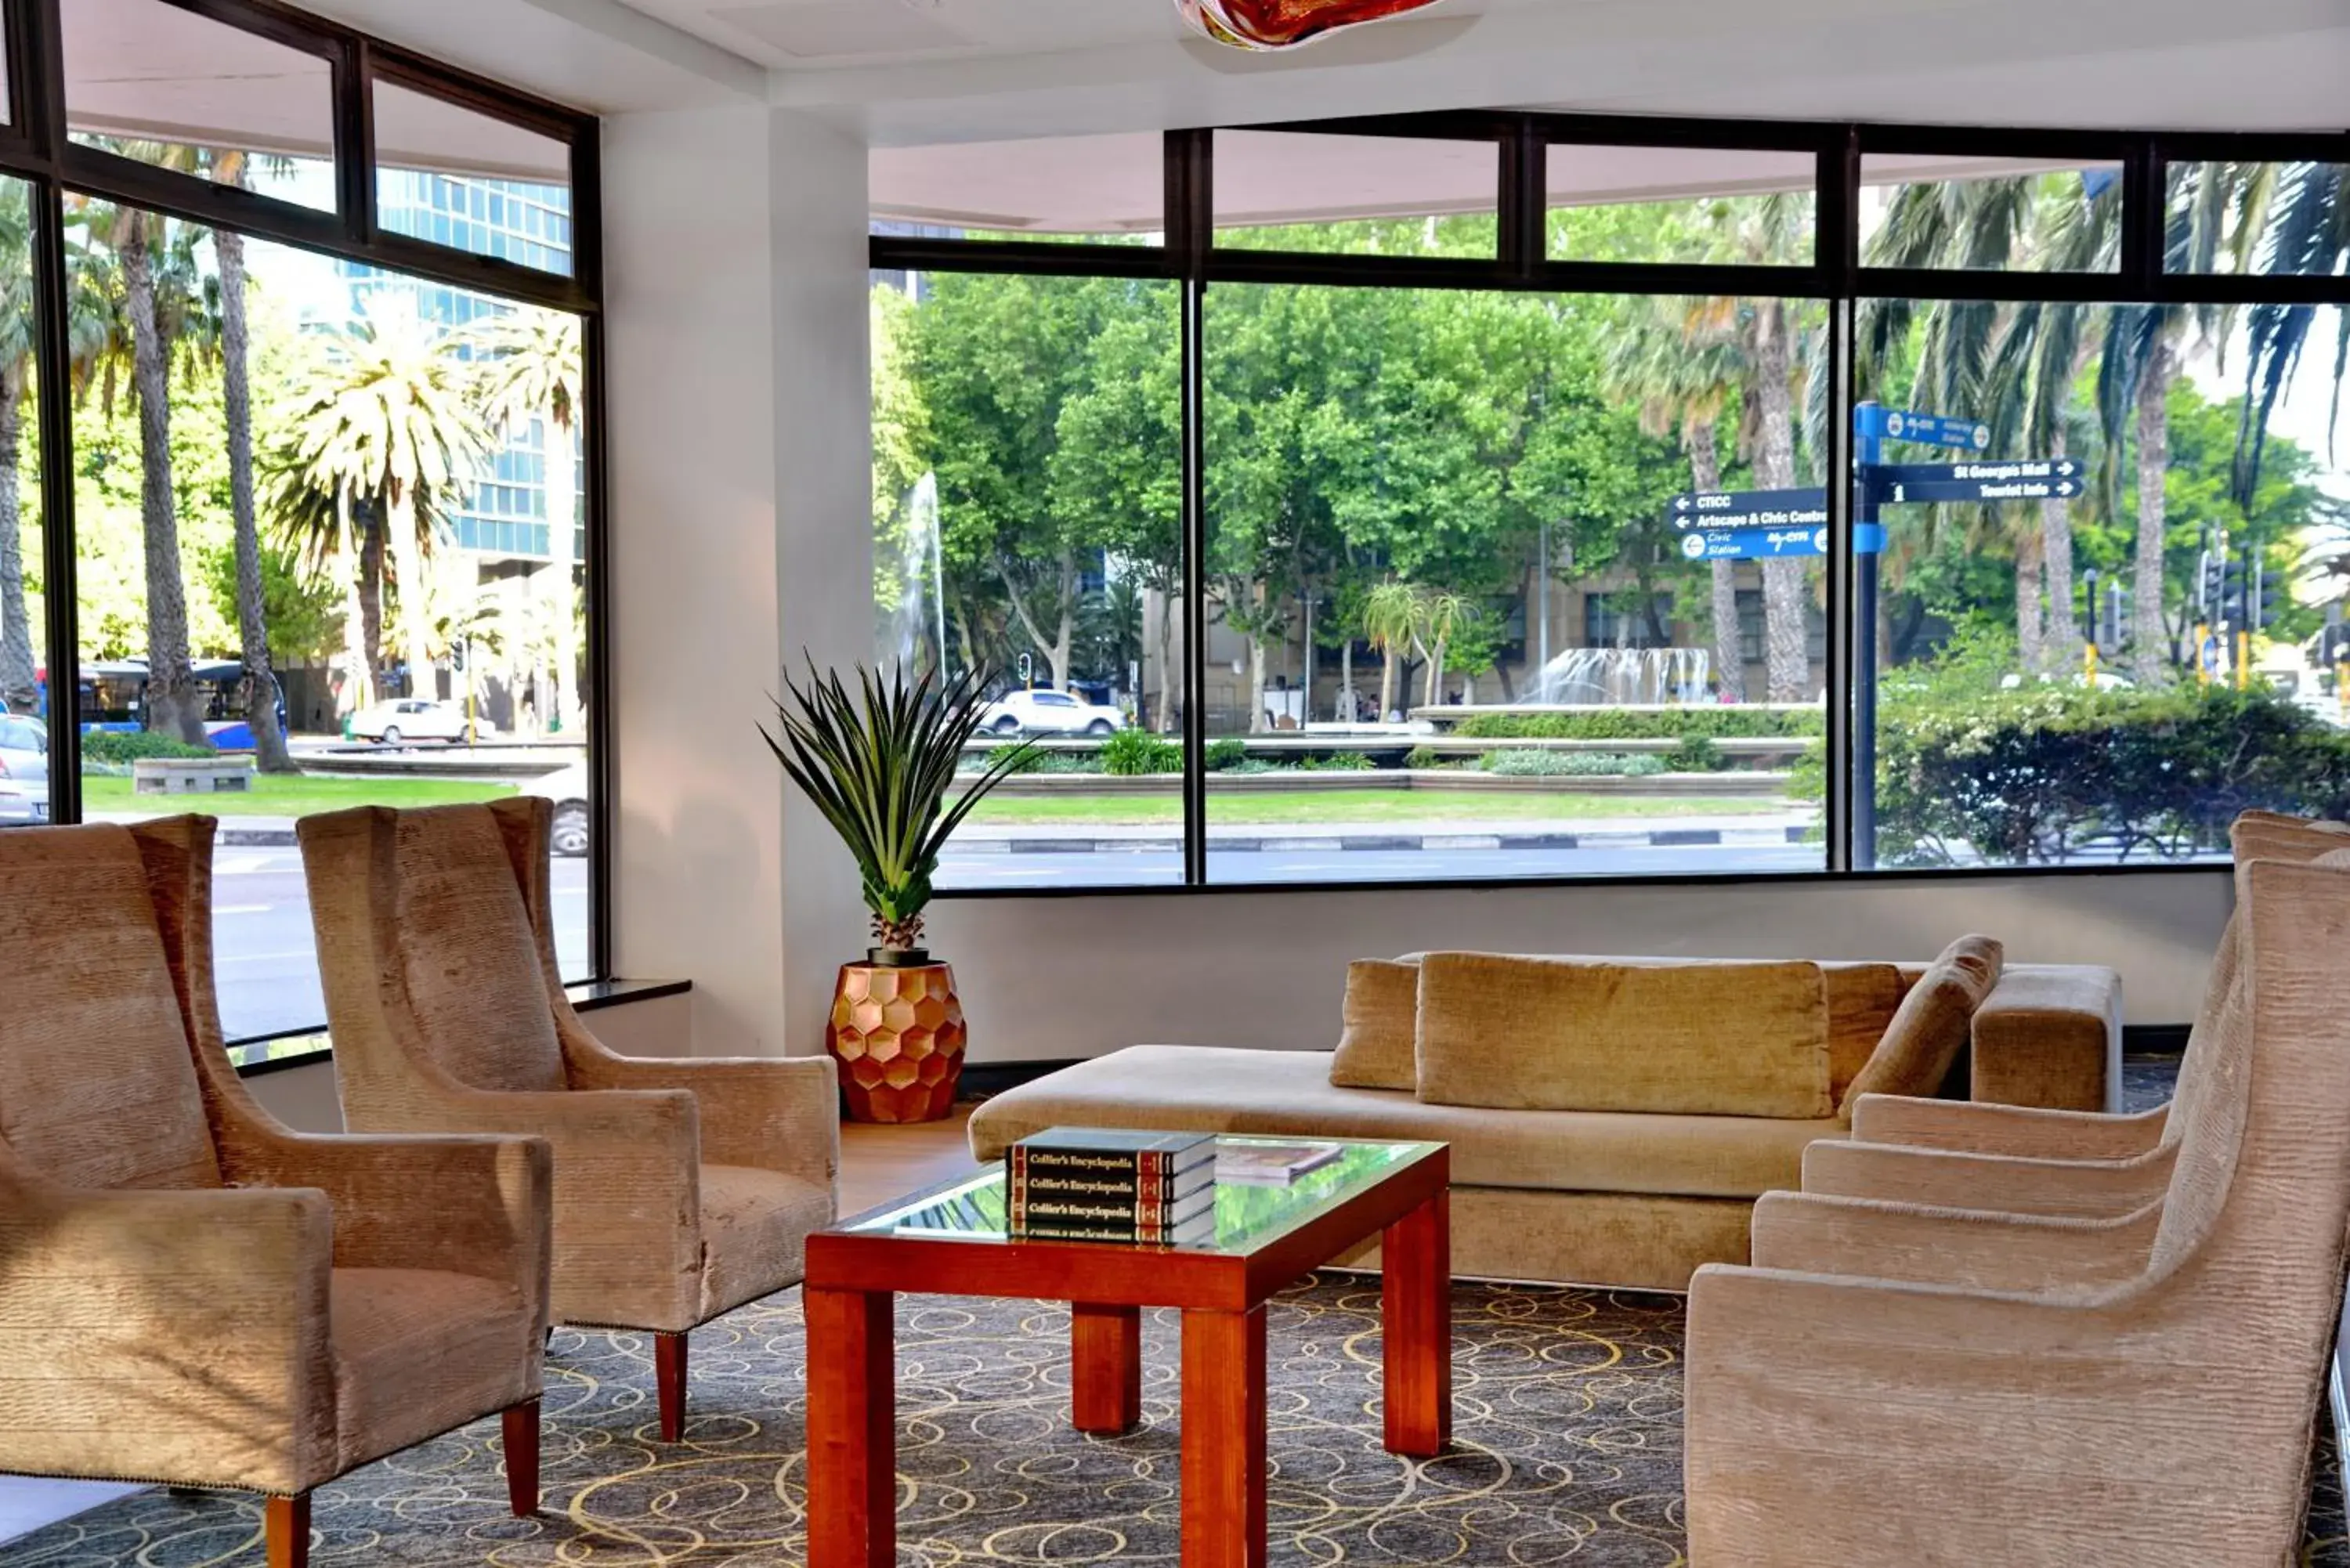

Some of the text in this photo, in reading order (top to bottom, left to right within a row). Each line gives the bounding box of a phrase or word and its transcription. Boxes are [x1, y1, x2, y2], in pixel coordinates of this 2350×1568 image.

[1954, 465, 1968, 479] St
[2021, 463, 2050, 476] Mall
[1980, 482, 2049, 497] Tourist Info
[1697, 496, 1731, 508] CTICC
[1697, 514, 1747, 527] Artscape
[1748, 513, 1759, 525] &
[1760, 511, 1788, 524] Civic
[1707, 533, 1732, 543] Civic
[1707, 544, 1741, 555] Station
[1030, 1154, 1068, 1165] Collier's
[1070, 1155, 1133, 1170] Encyclopedia
[1030, 1178, 1068, 1189] Collier's
[1070, 1179, 1133, 1194] Encyclopedia
[1029, 1202, 1068, 1213] Collier's
[1069, 1203, 1133, 1219] Encyclopedia
